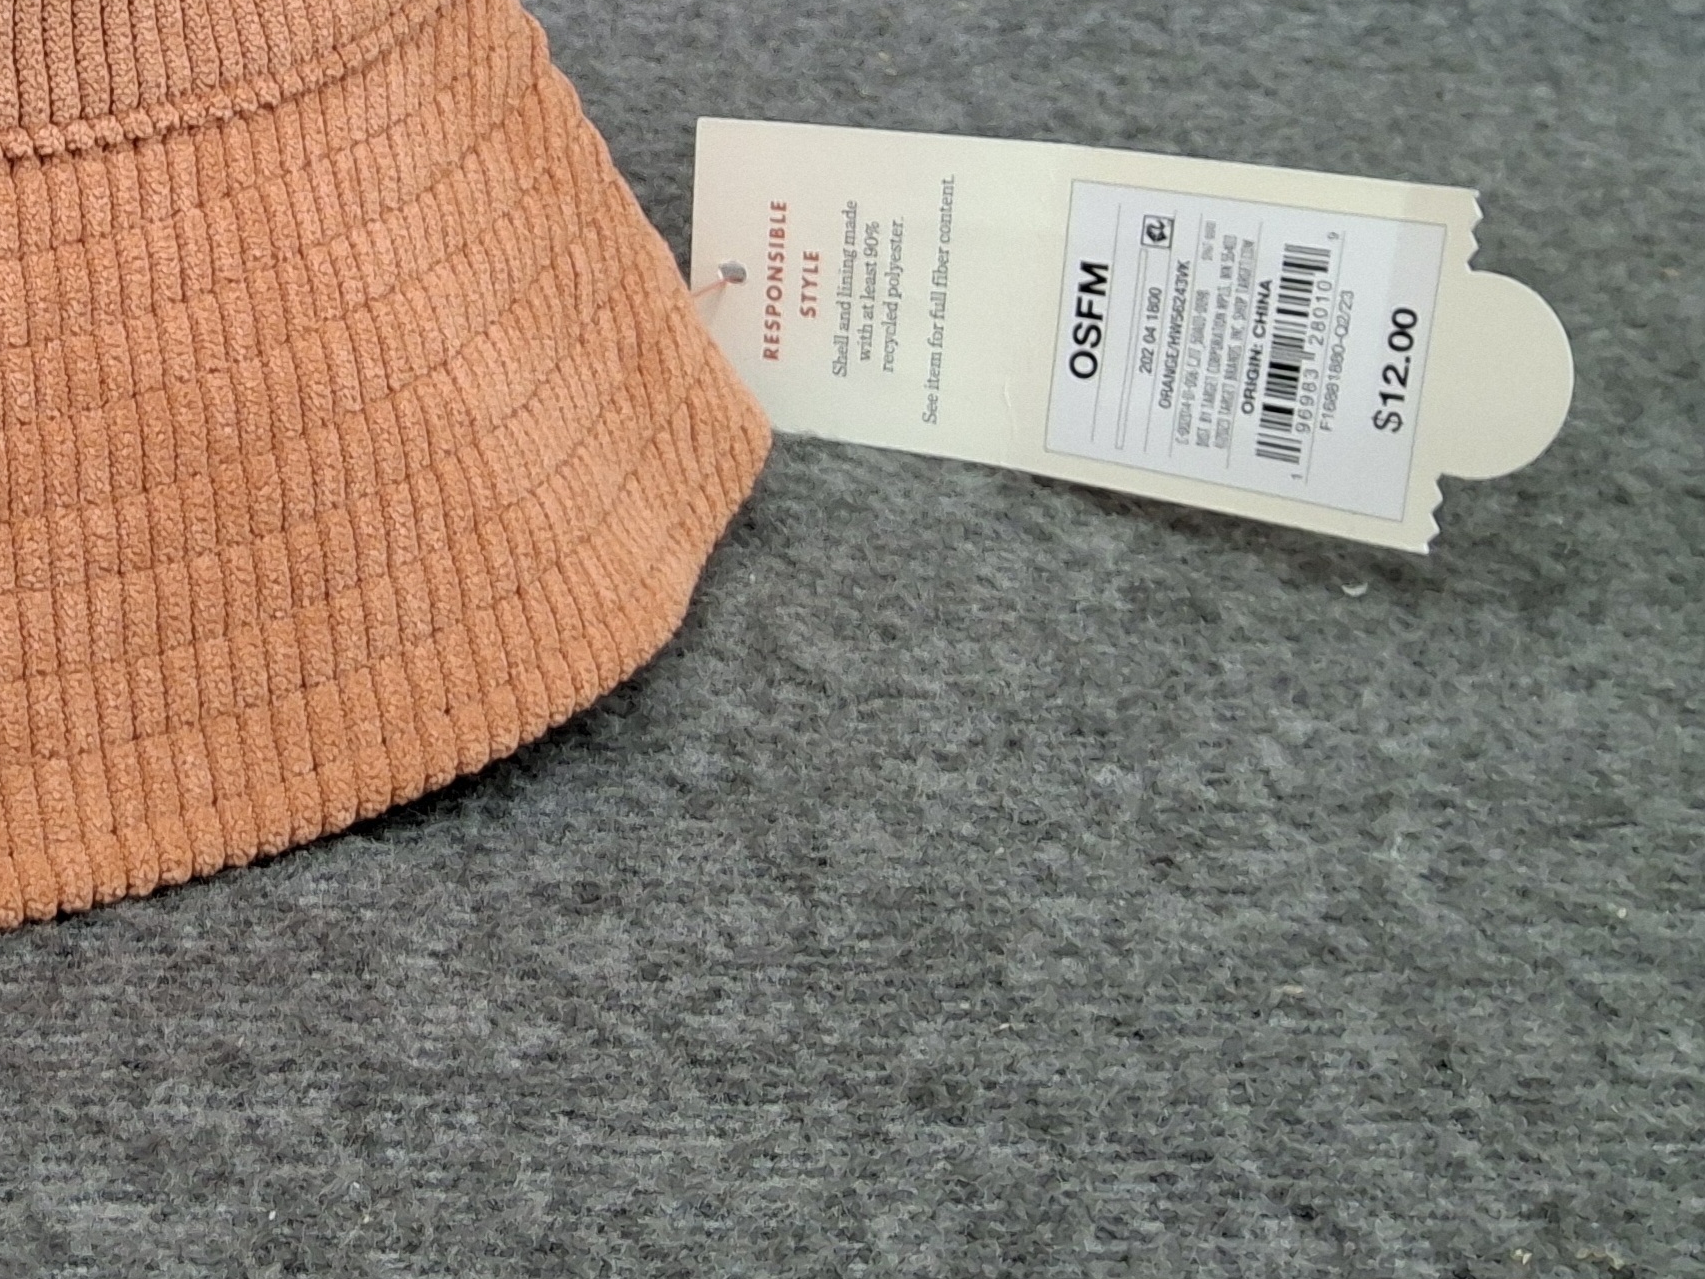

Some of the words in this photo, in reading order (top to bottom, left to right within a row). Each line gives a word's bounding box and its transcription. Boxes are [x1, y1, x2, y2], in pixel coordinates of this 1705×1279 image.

[841, 200, 858, 246] made
[937, 174, 955, 244] content.
[864, 221, 880, 258] 90%
[885, 216, 905, 298] polyester.
[762, 201, 788, 361] RESPONSIBLE
[800, 250, 820, 319] STYLE
[837, 249, 856, 297] lining
[861, 261, 877, 300] least
[932, 247, 949, 287] fiber
[835, 301, 852, 331] and
[861, 304, 875, 320] at
[929, 291, 947, 320] full
[1067, 260, 1110, 381] OSFM
[1145, 286, 1163, 322] 1800
[1251, 278, 1273, 339] CHINA
[857, 324, 873, 361] with
[879, 302, 899, 372] recycled
[928, 321, 944, 348] for
[1142, 326, 1157, 344] 04
[832, 335, 849, 378] Shell
[925, 351, 942, 391] item
[1139, 348, 1155, 374] 202
[1295, 368, 1319, 433] 96983
[1308, 280, 1333, 346] 28010
[1370, 306, 1419, 434] $12.00
[1241, 344, 1264, 415] ORIGIN:
[923, 394, 939, 424] See
